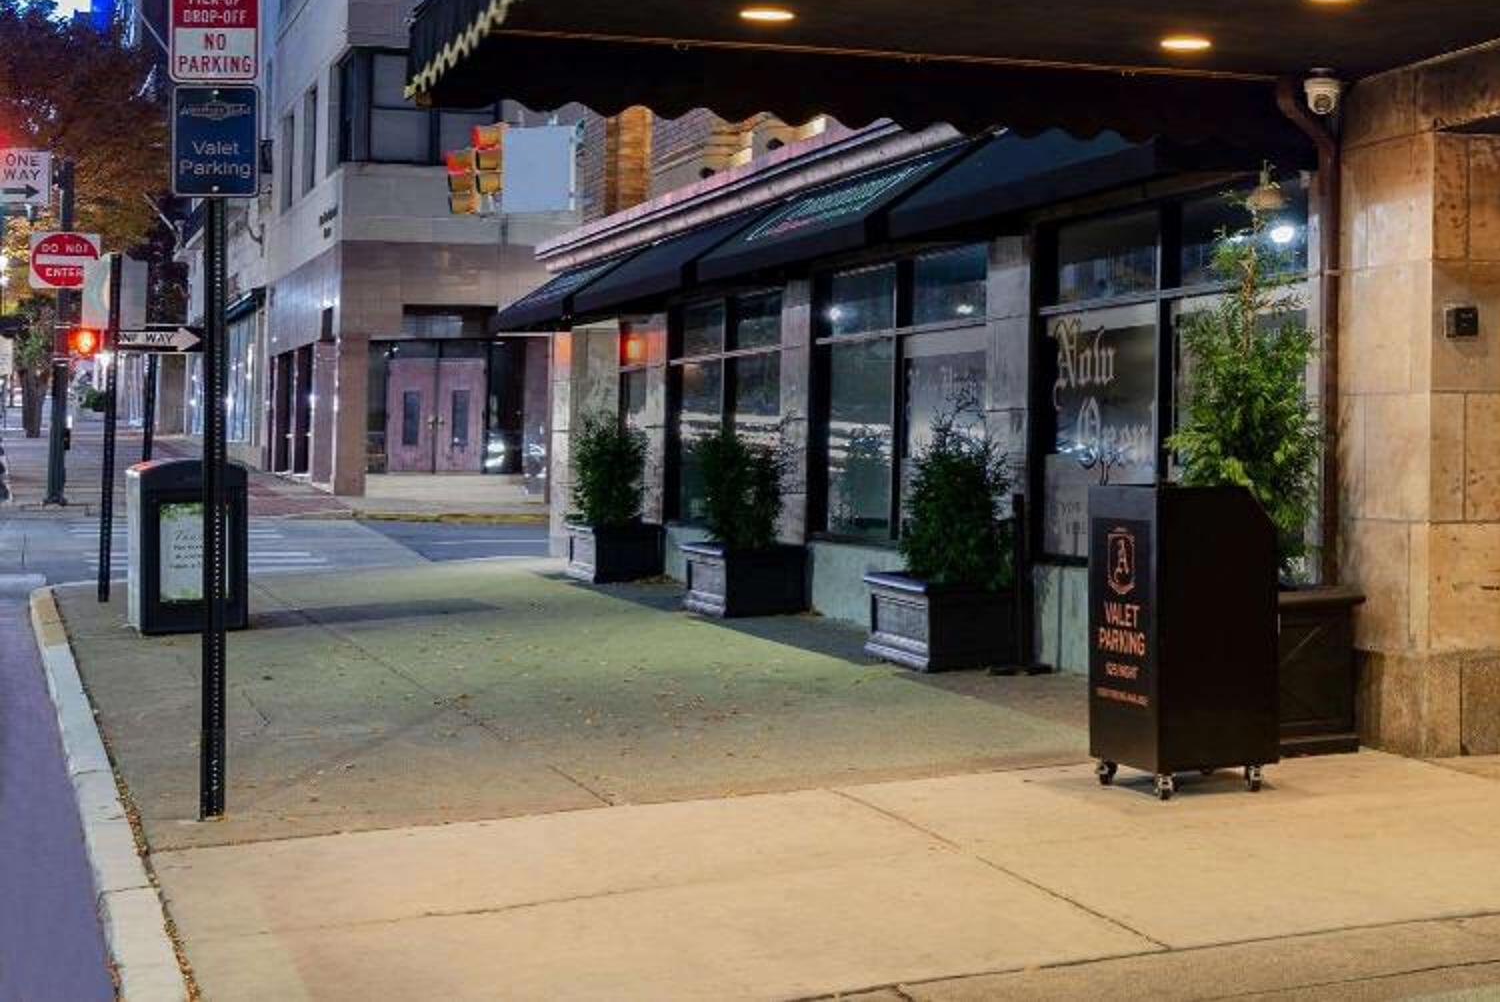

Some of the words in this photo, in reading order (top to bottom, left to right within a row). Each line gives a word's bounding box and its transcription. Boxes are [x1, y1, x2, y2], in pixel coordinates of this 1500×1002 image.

[183, 9, 248, 24] DROP-OFF
[204, 33, 226, 51] NO
[178, 55, 252, 73] PARKING
[191, 140, 240, 155] Valet
[5, 153, 39, 167] ONE
[3, 169, 41, 181] WAY
[179, 159, 251, 179] Parking
[41, 243, 59, 253] DO
[65, 244, 88, 254] NOT
[118, 333, 138, 343] NE
[146, 333, 174, 343] WAY
[1053, 318, 1117, 410] Now
[1104, 601, 1140, 628] VALET
[1098, 626, 1146, 657] PARKING
